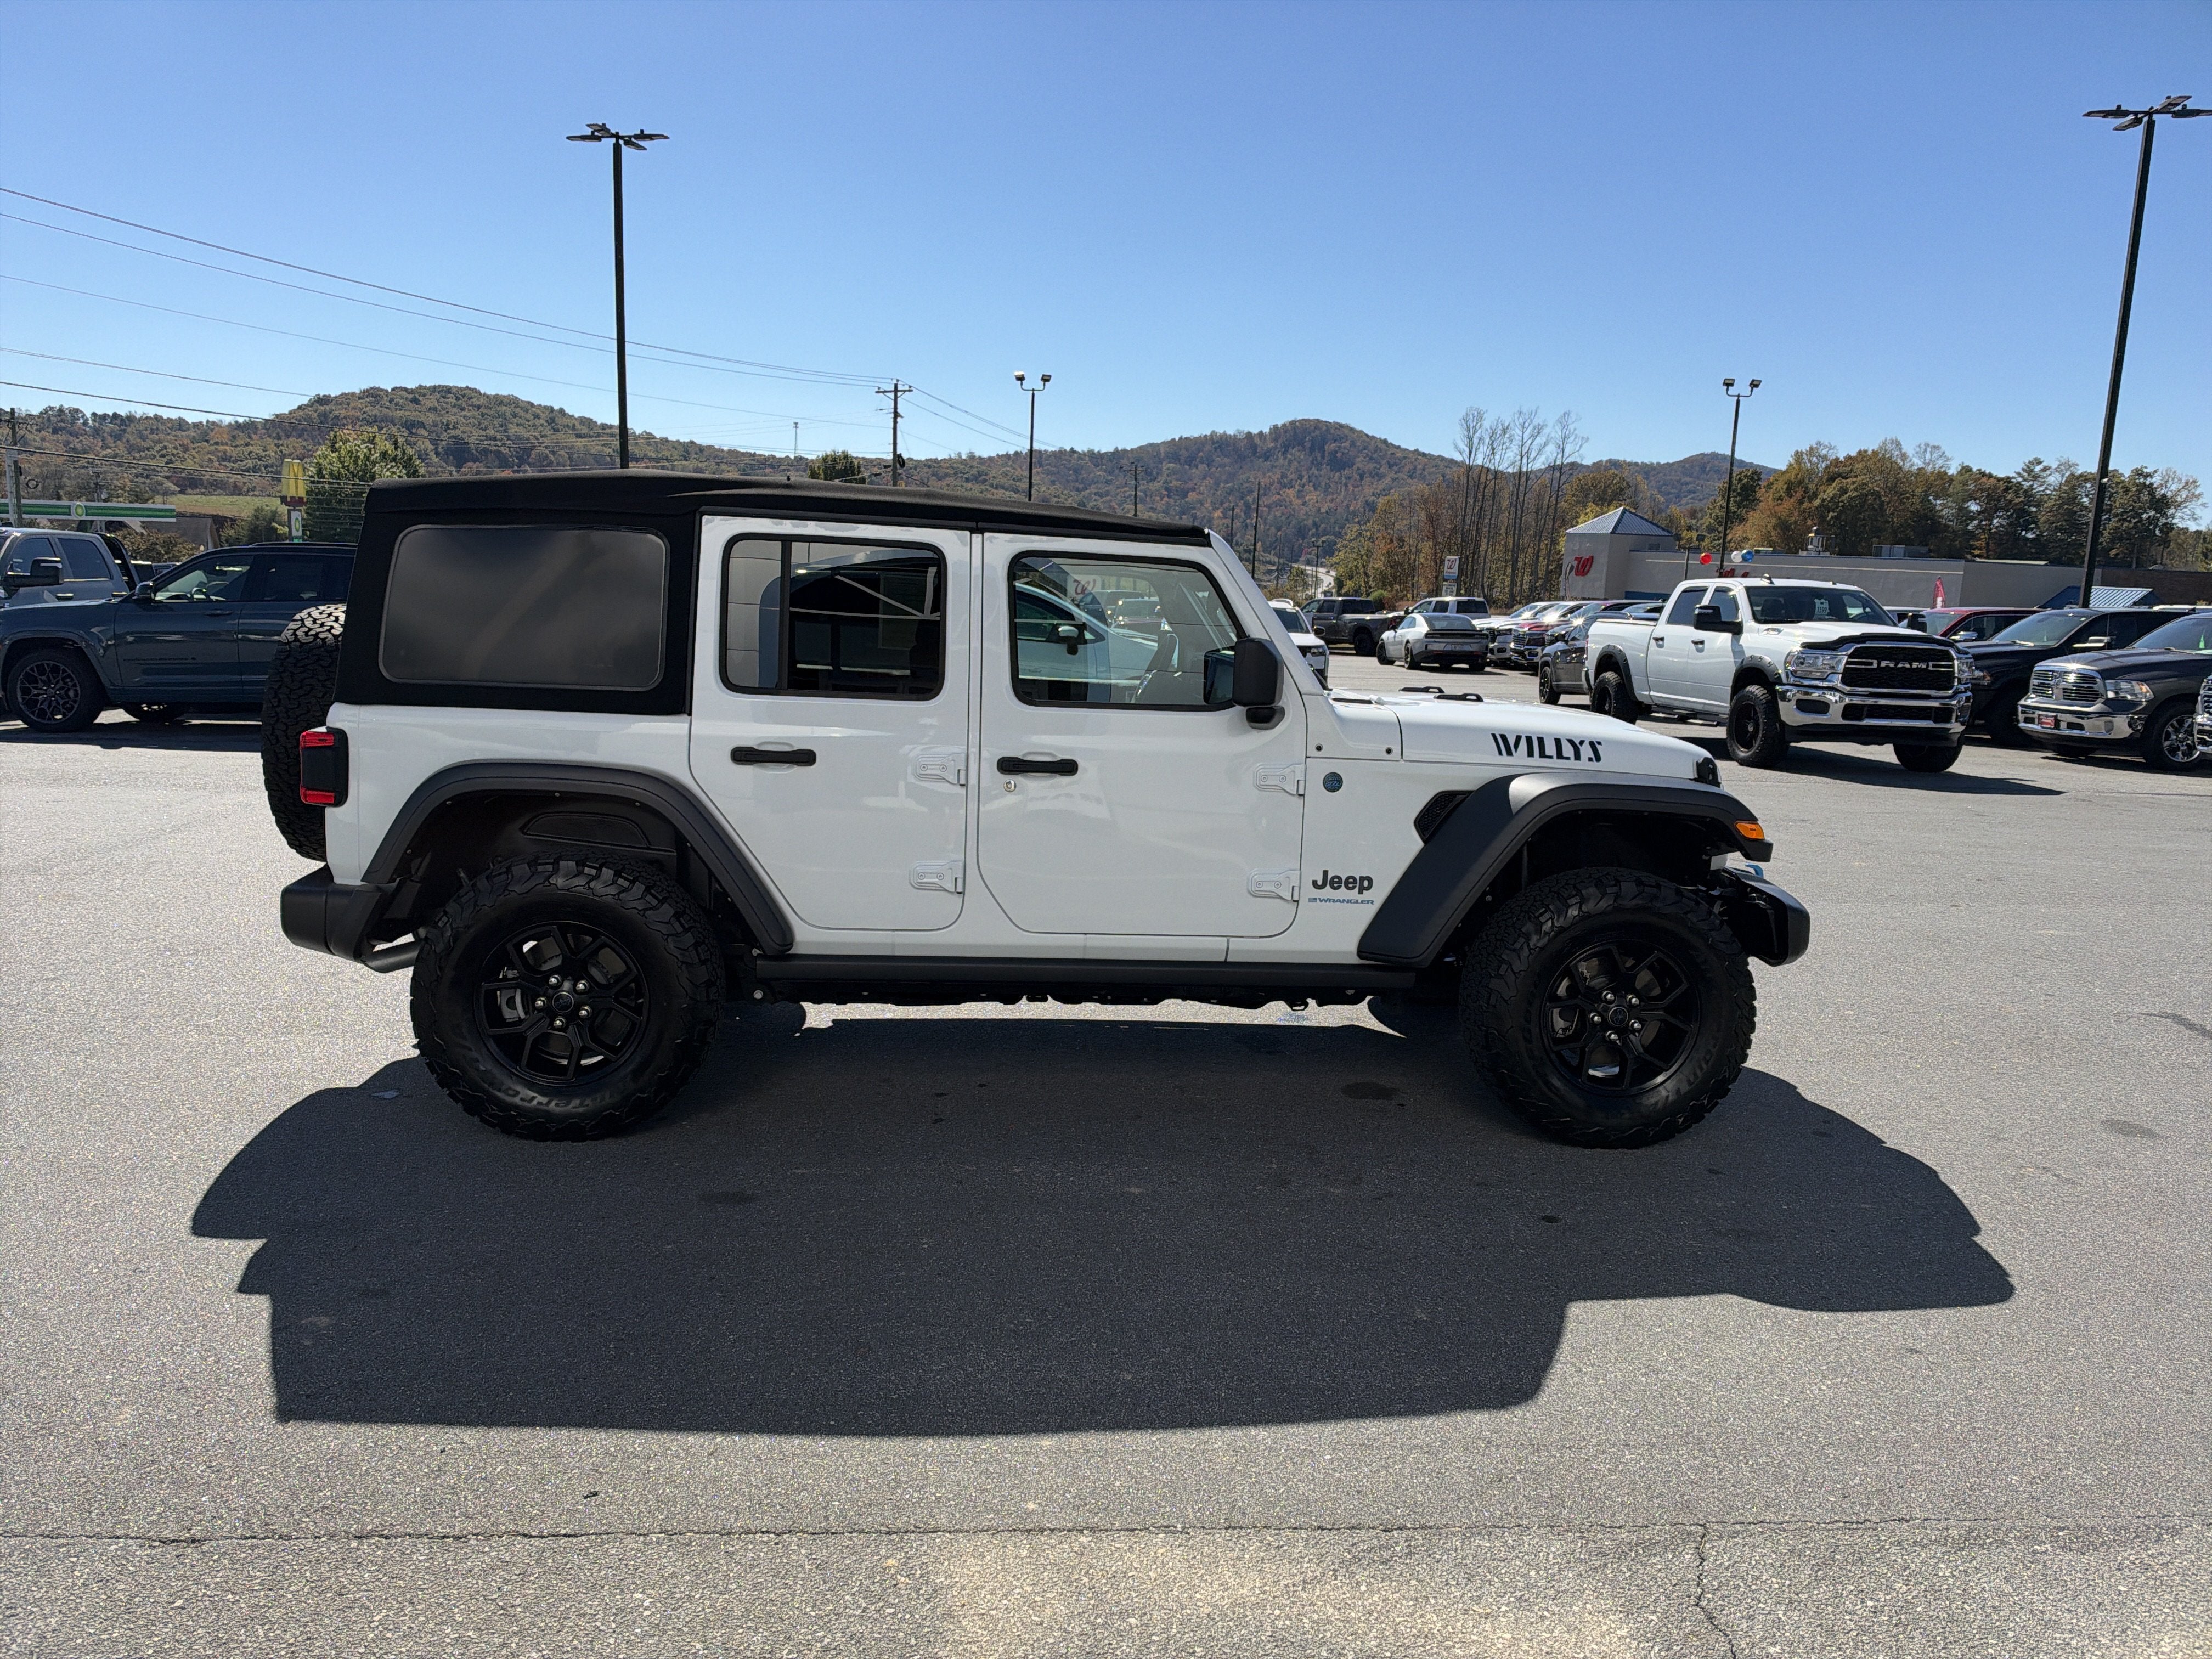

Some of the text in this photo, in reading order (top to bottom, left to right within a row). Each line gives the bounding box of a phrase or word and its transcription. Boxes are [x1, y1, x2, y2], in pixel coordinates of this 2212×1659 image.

[1880, 661, 1927, 669] RAM
[1491, 733, 1602, 763] WILLYS
[1312, 870, 1373, 895] Jeep
[1318, 897, 1374, 905] WRANGLER
